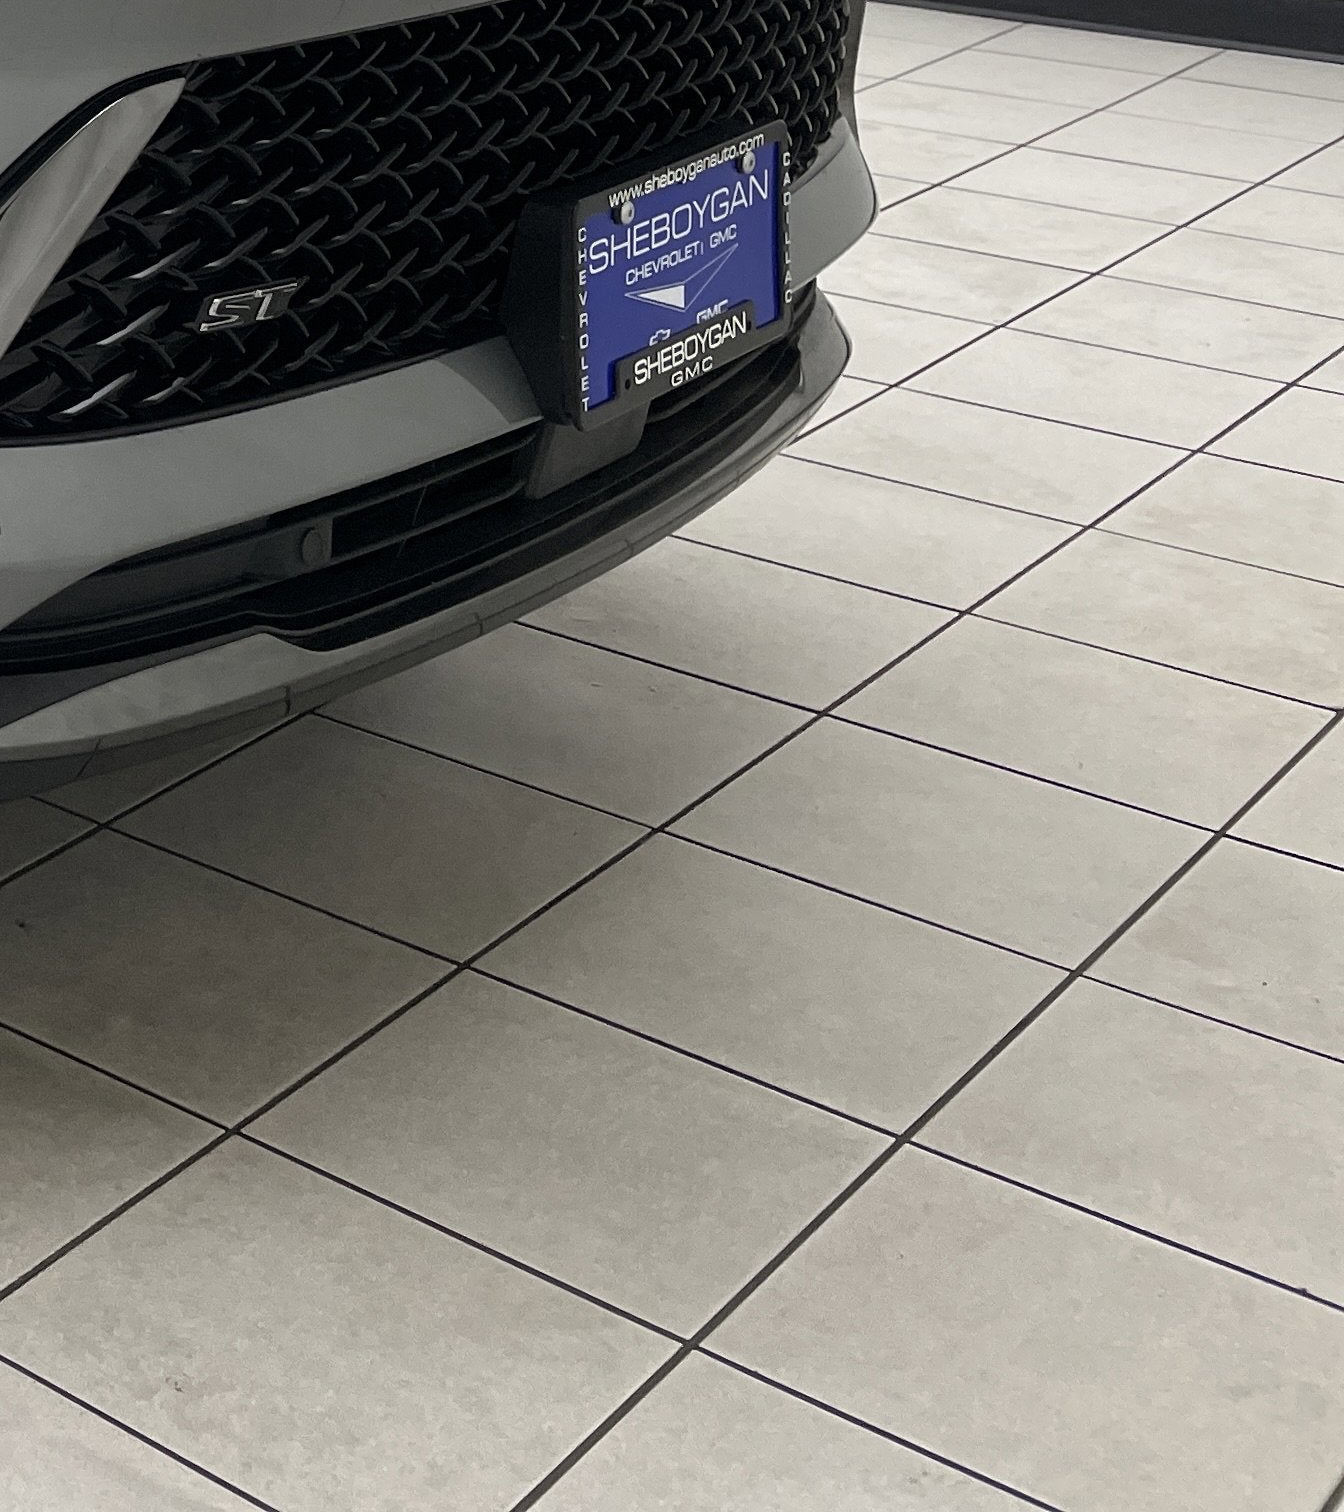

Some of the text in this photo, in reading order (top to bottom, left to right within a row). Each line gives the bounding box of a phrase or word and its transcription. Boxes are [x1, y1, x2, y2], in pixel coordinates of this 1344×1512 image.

[609, 132, 765, 208] www.sheboyganauto.com
[588, 169, 769, 275] SHEBOYGAN
[709, 223, 737, 249] GMC
[577, 227, 590, 412] CHEVROLET
[634, 311, 748, 386] SHEBOYGAN
[671, 355, 714, 388] GMC
